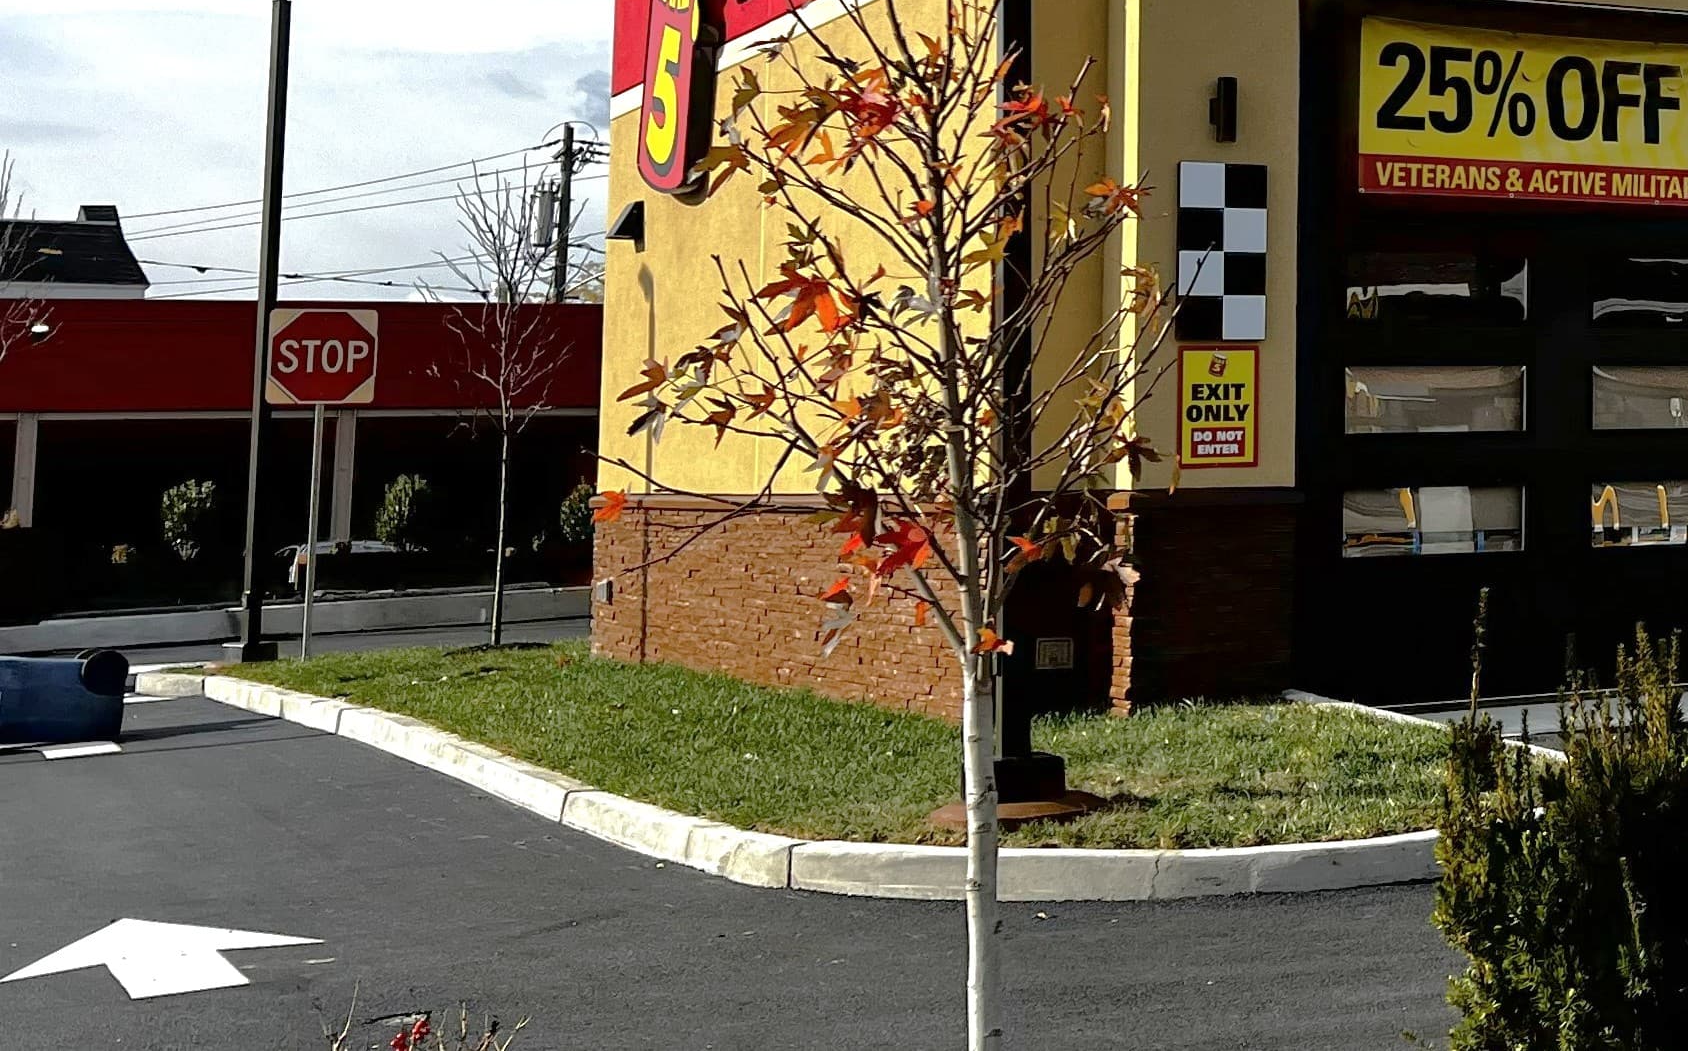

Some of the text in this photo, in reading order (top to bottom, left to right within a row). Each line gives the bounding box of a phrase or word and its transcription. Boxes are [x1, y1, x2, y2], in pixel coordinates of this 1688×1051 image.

[646, 28, 682, 164] 5
[1376, 41, 1682, 144] 25% OFF
[1376, 161, 1501, 191] VETERANS
[1505, 168, 1524, 192] &
[1528, 169, 1607, 196] ACTIVE
[277, 339, 369, 374] STOP
[1191, 383, 1245, 401] EXIT
[1186, 404, 1250, 422] ONLY
[1193, 431, 1244, 442] DO NOT
[1197, 444, 1239, 455] ENTER
